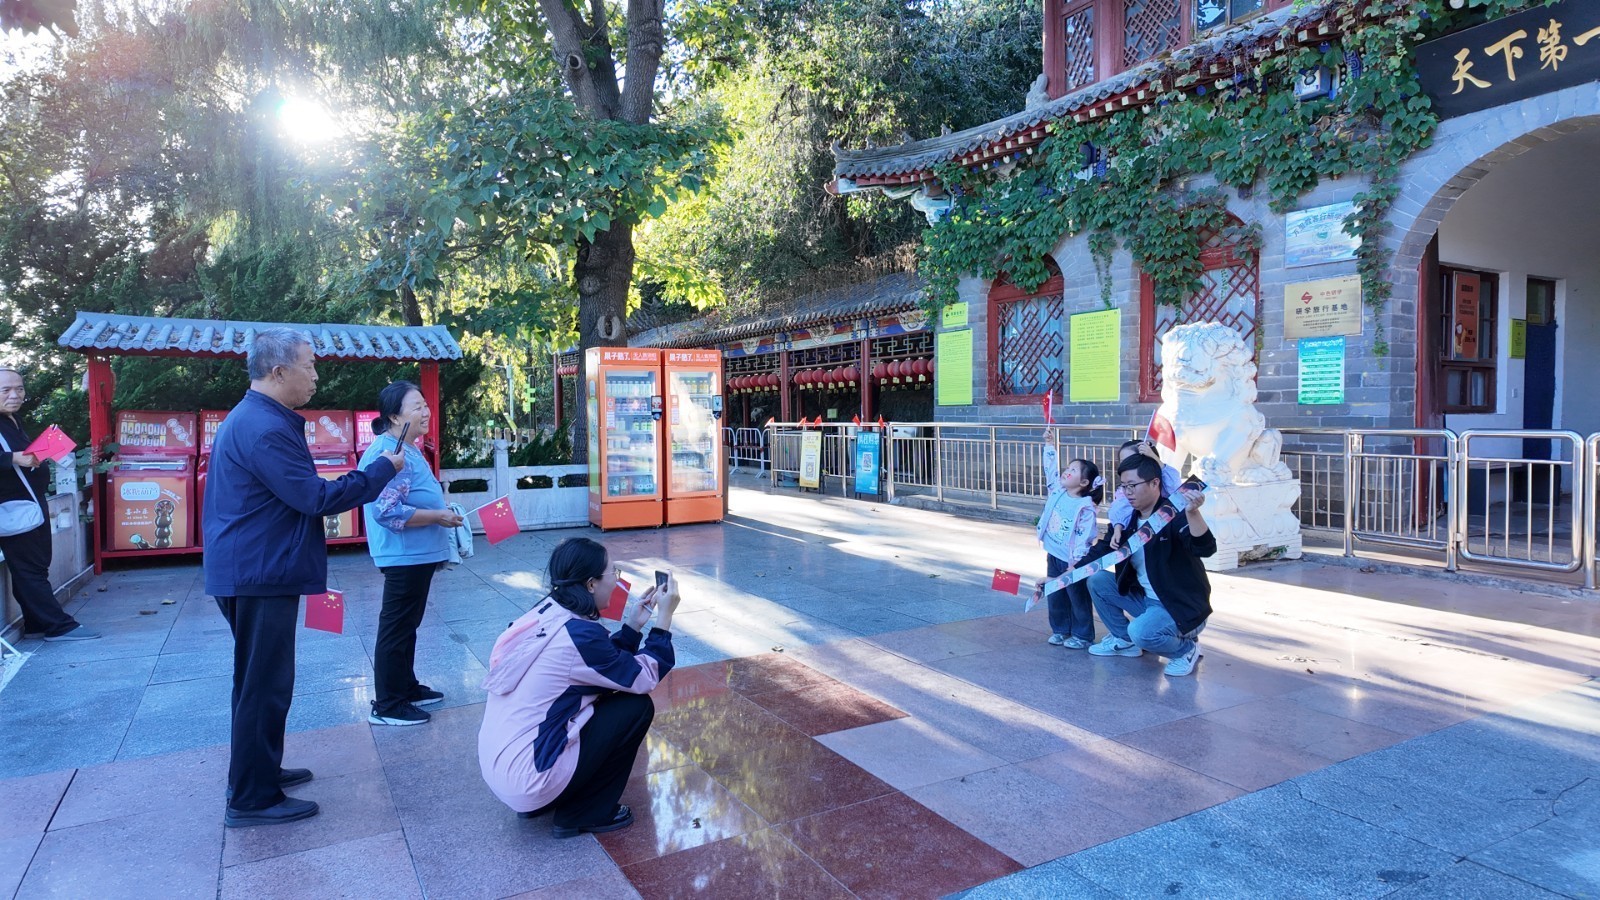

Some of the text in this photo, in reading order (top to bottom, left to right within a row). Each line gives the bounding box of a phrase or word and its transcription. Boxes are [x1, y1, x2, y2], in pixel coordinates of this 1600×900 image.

[1451, 19, 1600, 95] 天下第一
[1296, 303, 1348, 315] 研学旅行基地
